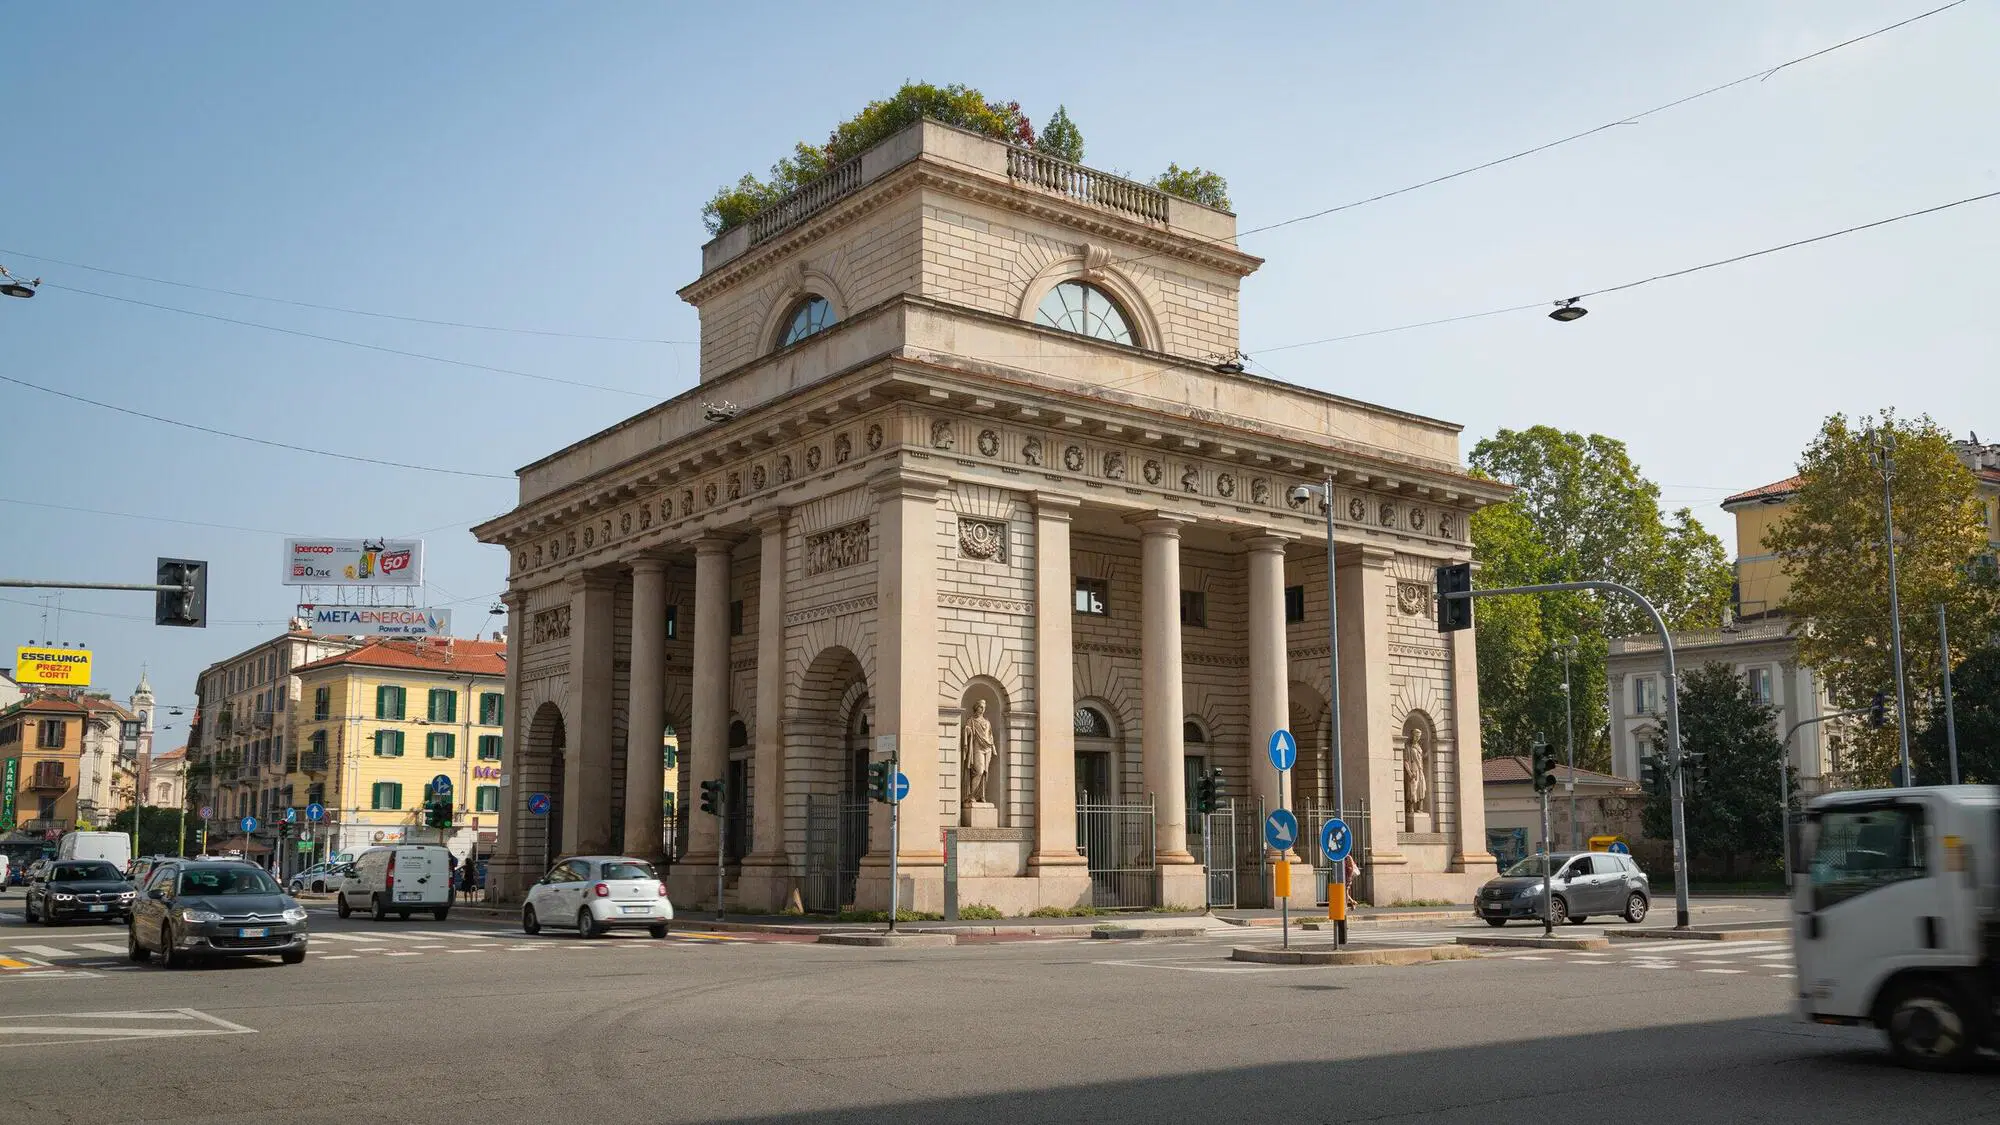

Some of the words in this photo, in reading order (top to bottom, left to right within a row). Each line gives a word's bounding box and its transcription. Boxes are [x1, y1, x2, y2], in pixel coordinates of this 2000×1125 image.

[295, 544, 334, 554] ipercoop
[317, 611, 426, 624] METAENERGIA
[379, 625, 402, 633] Power
[404, 625, 409, 633] &
[21, 652, 88, 663] ESSELUNGA
[36, 664, 72, 672] PREZZI
[39, 671, 68, 679] CORTI
[4, 760, 15, 815] FARMACIA
